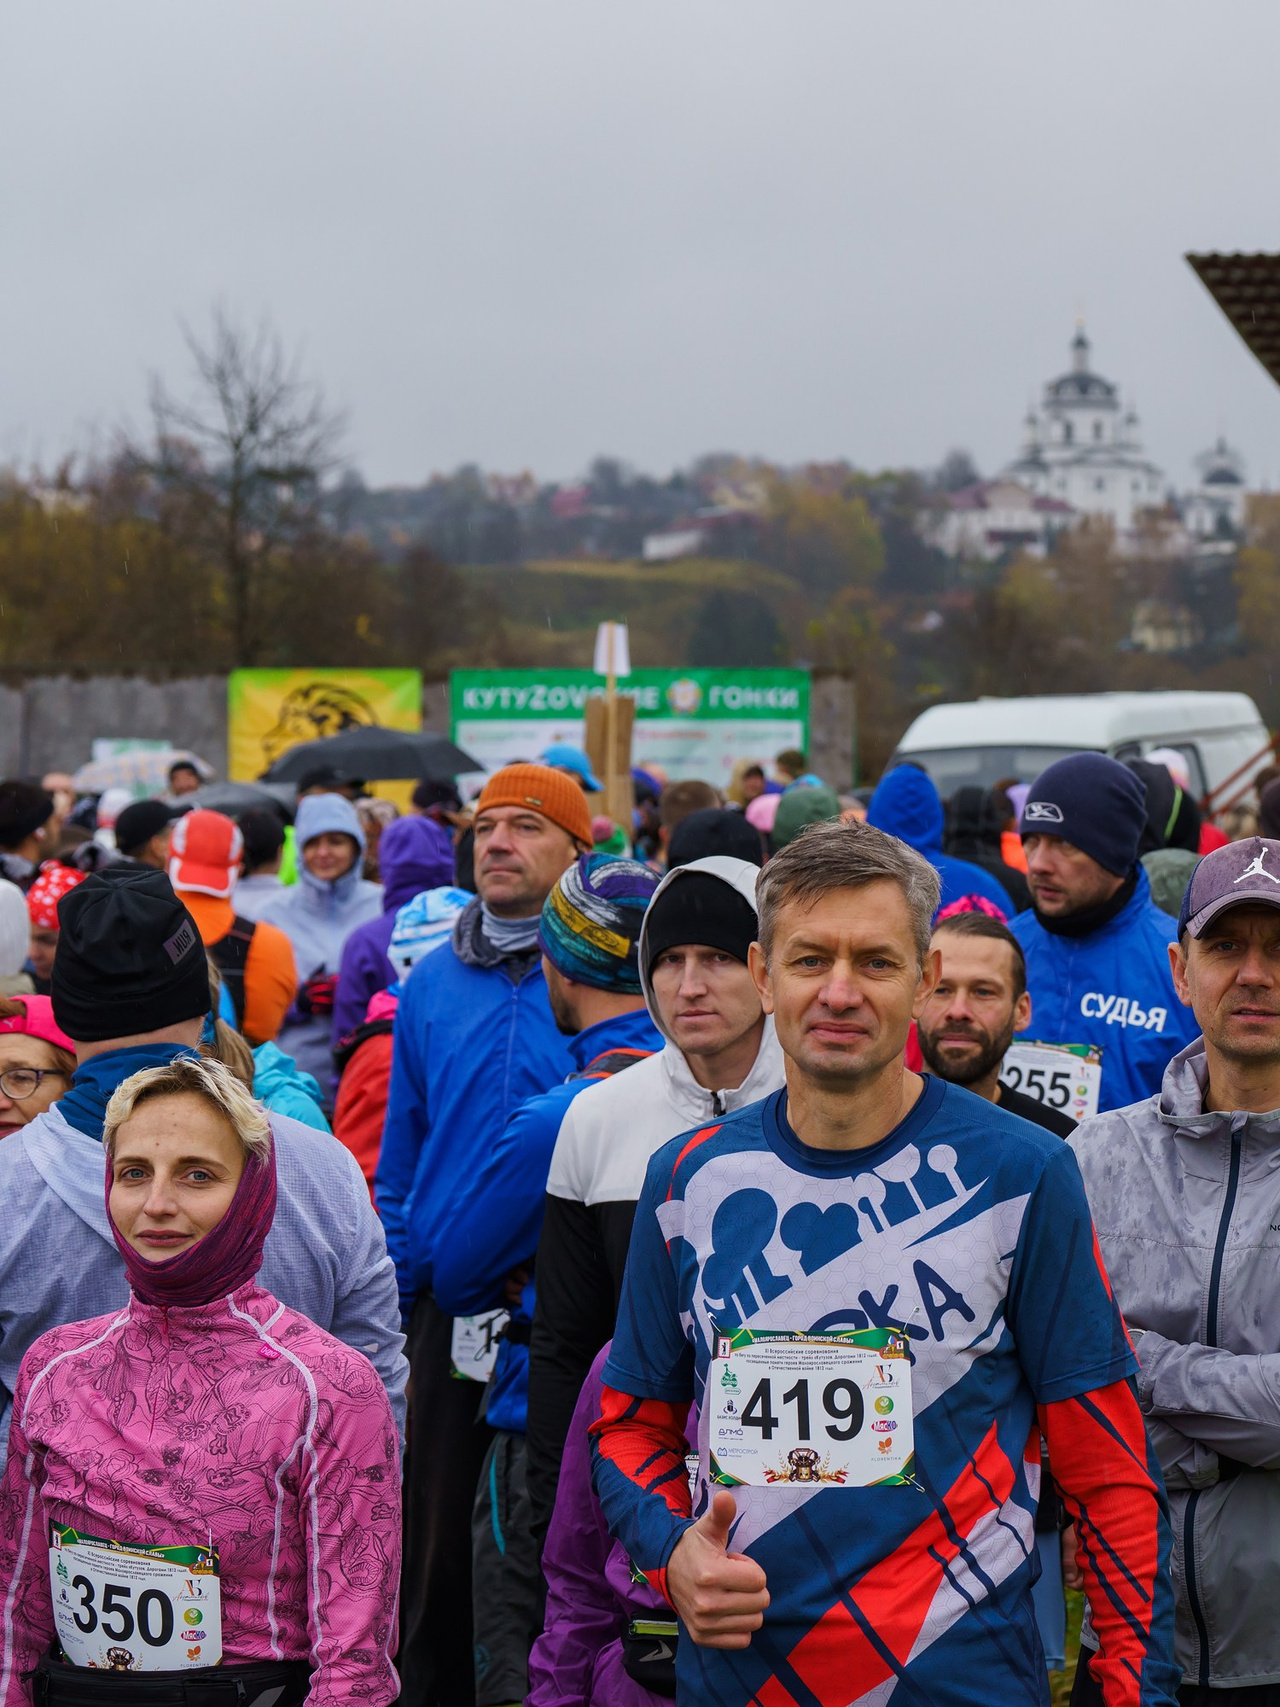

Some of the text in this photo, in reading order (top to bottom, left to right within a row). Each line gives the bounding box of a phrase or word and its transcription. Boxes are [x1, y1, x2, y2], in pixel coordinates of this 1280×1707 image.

[709, 686, 798, 710] ГОНКИ
[1080, 992, 1167, 1033] СУДЬЯ
[1006, 1066, 1071, 1108] 255
[741, 1378, 865, 1442] 419
[72, 1574, 174, 1647] 350
